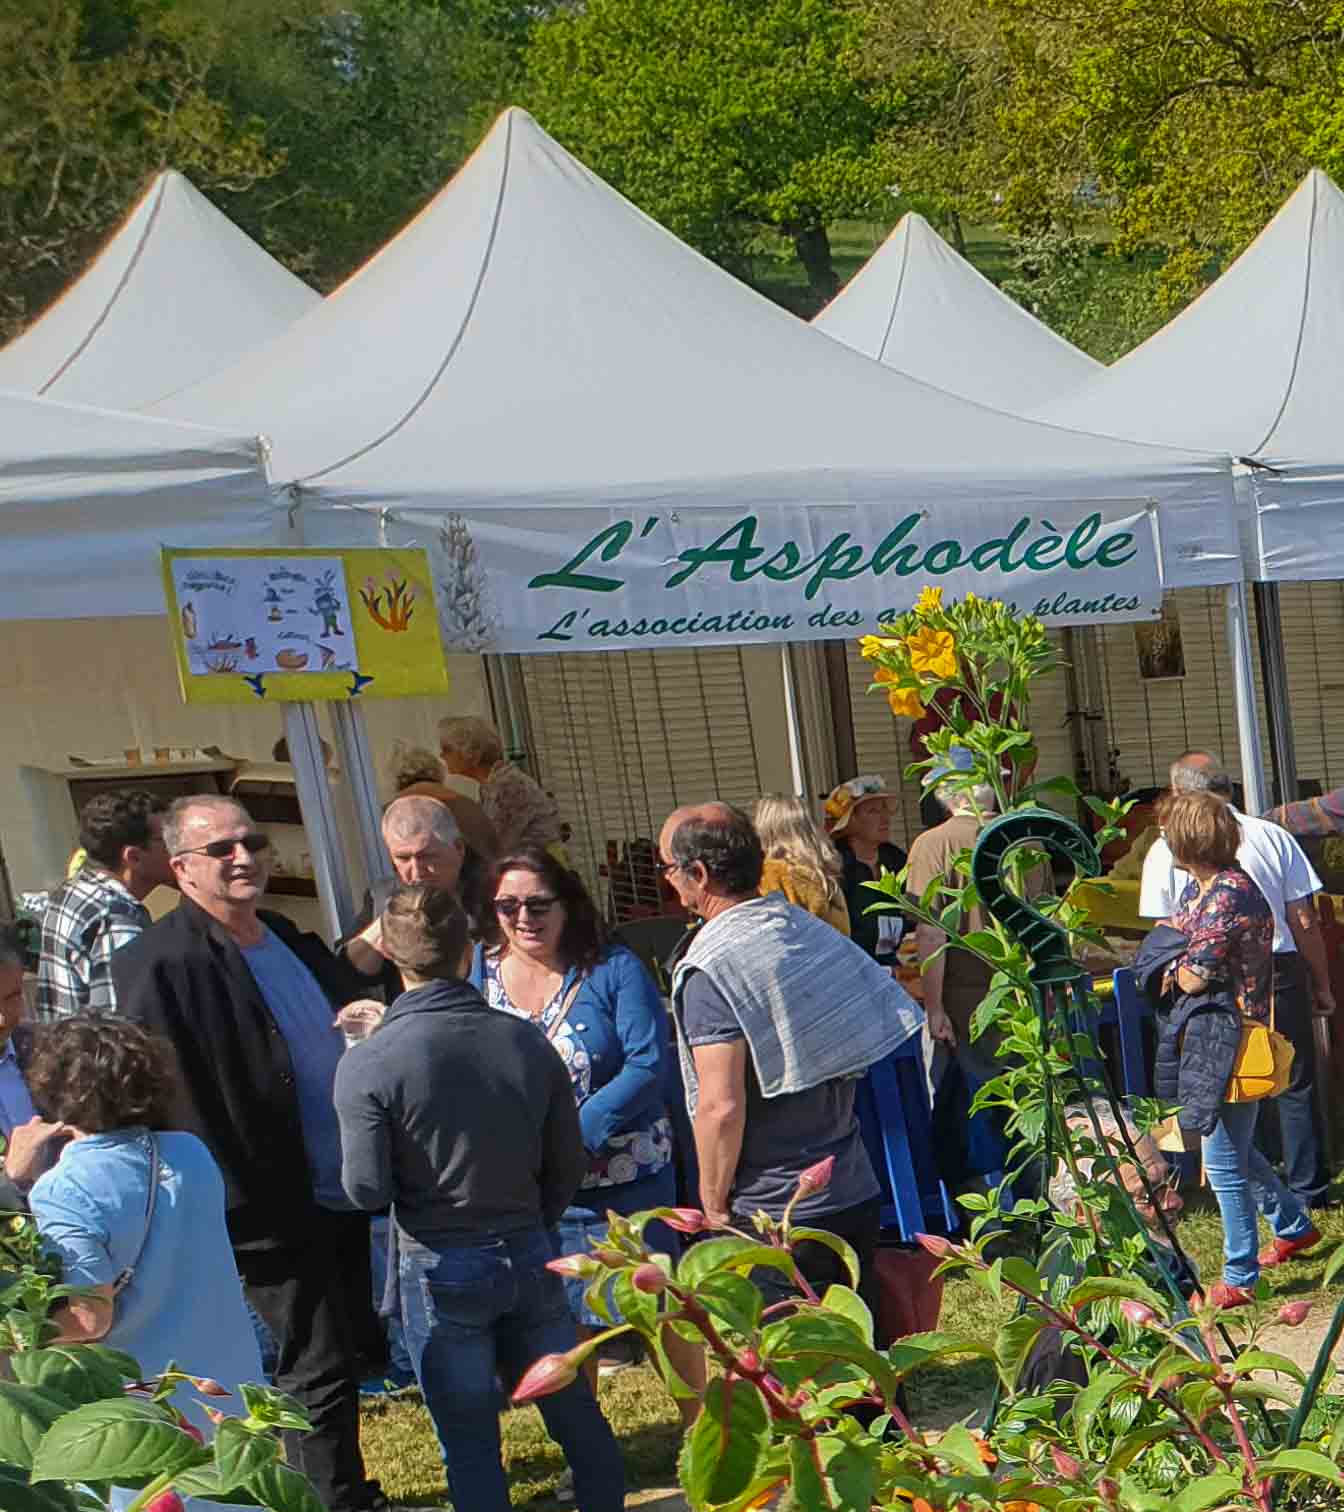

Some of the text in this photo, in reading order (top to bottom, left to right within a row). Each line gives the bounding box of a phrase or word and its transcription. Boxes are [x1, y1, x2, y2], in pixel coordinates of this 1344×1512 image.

[527, 511, 1139, 601] L'Asphodèle
[536, 607, 794, 641] L'association
[808, 603, 865, 630] des
[1032, 591, 1143, 618] plantes
